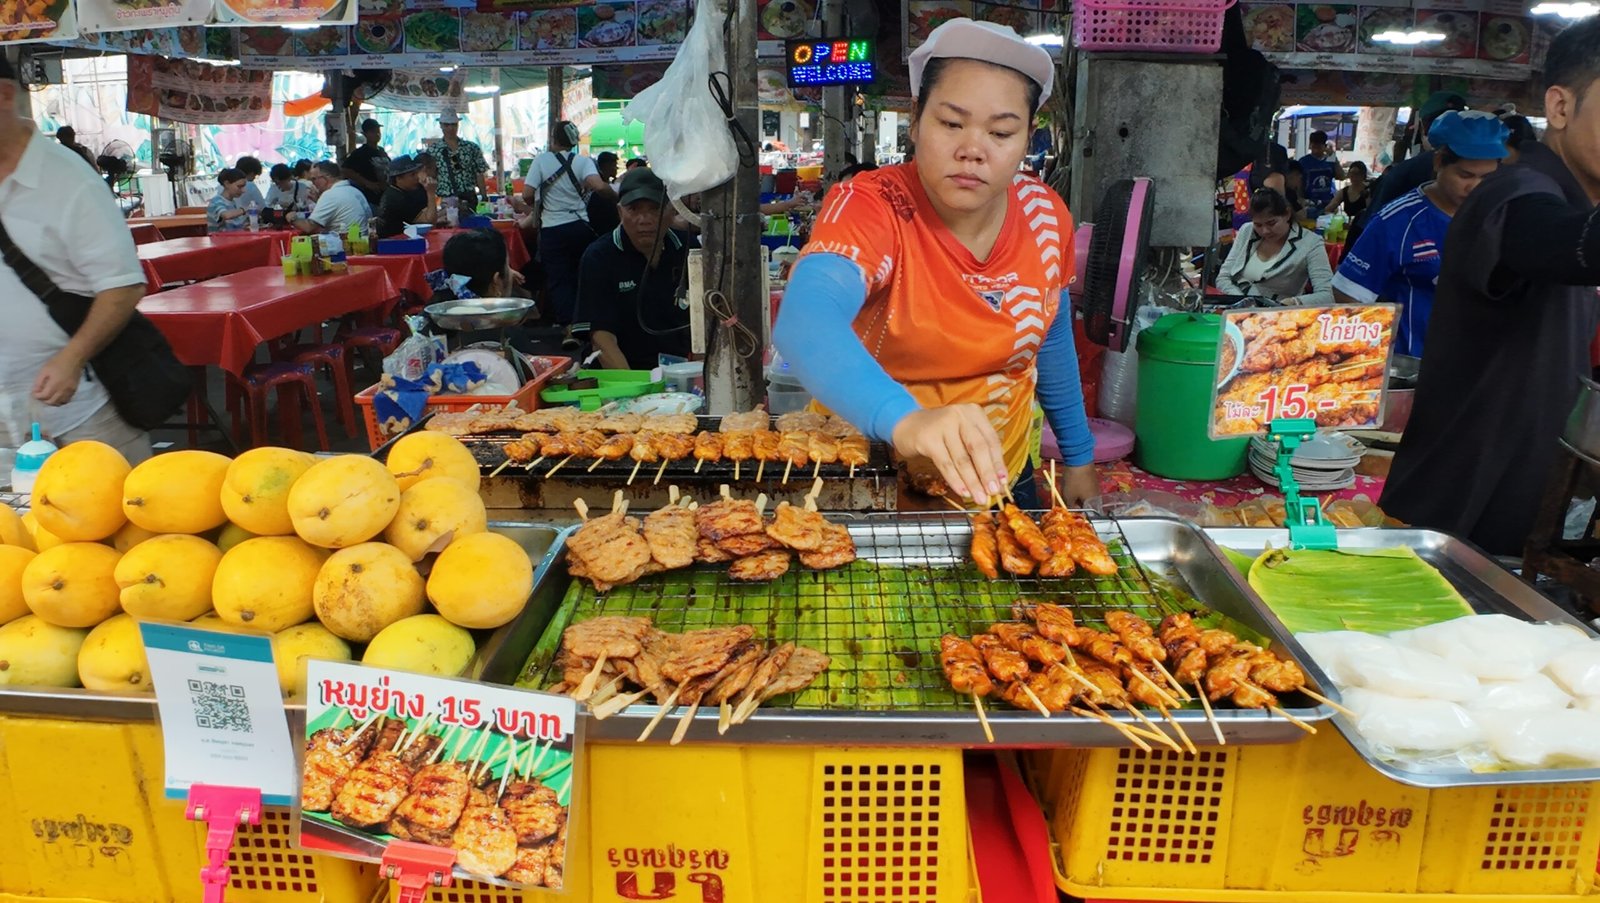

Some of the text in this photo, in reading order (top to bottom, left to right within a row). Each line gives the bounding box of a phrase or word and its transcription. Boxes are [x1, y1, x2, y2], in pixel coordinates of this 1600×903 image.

[794, 42, 866, 64] OPEN
[792, 63, 872, 82] WELCOME
[1318, 315, 1380, 342] ไก่ย่าง
[1224, 401, 1260, 419] ไม้ละ
[320, 675, 563, 740] หมูย่าง 15 บาท
